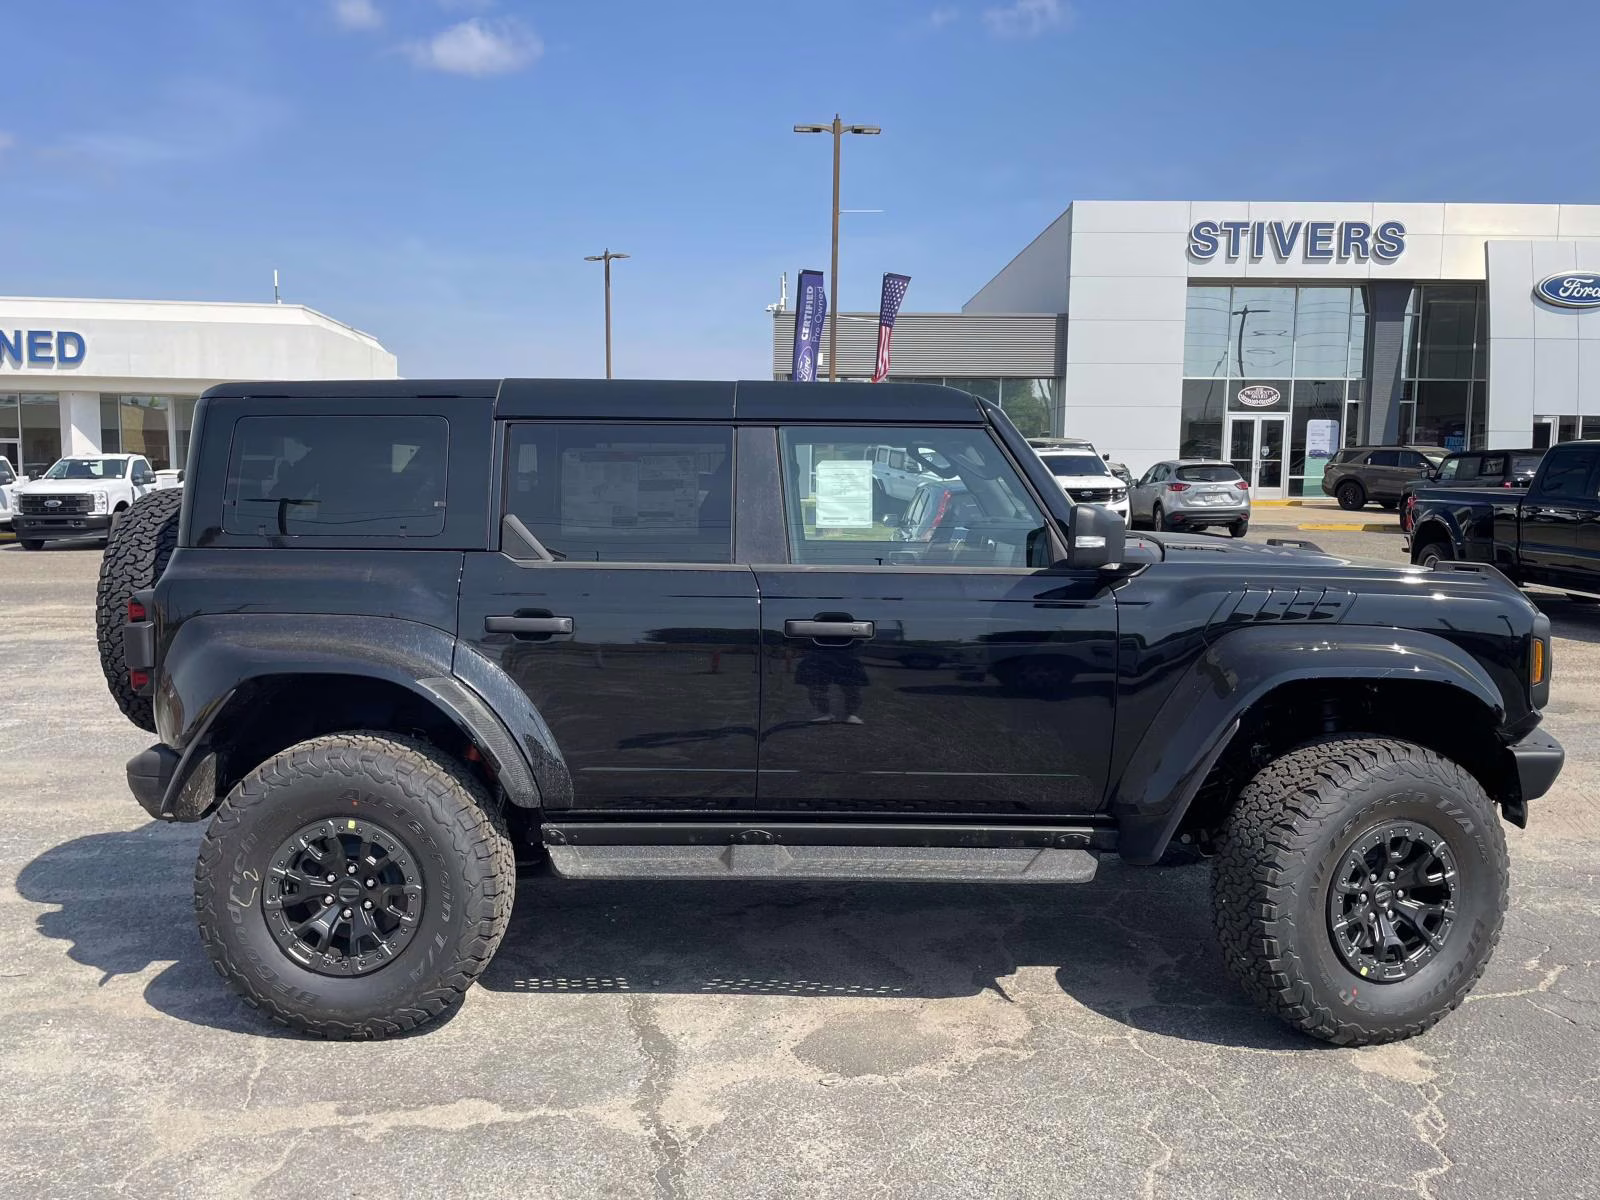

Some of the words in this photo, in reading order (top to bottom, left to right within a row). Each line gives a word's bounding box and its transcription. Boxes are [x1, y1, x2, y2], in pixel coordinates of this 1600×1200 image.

[1189, 220, 1407, 259] STIVERS
[802, 286, 813, 340] CERTIFIED
[799, 355, 811, 382] Ford
